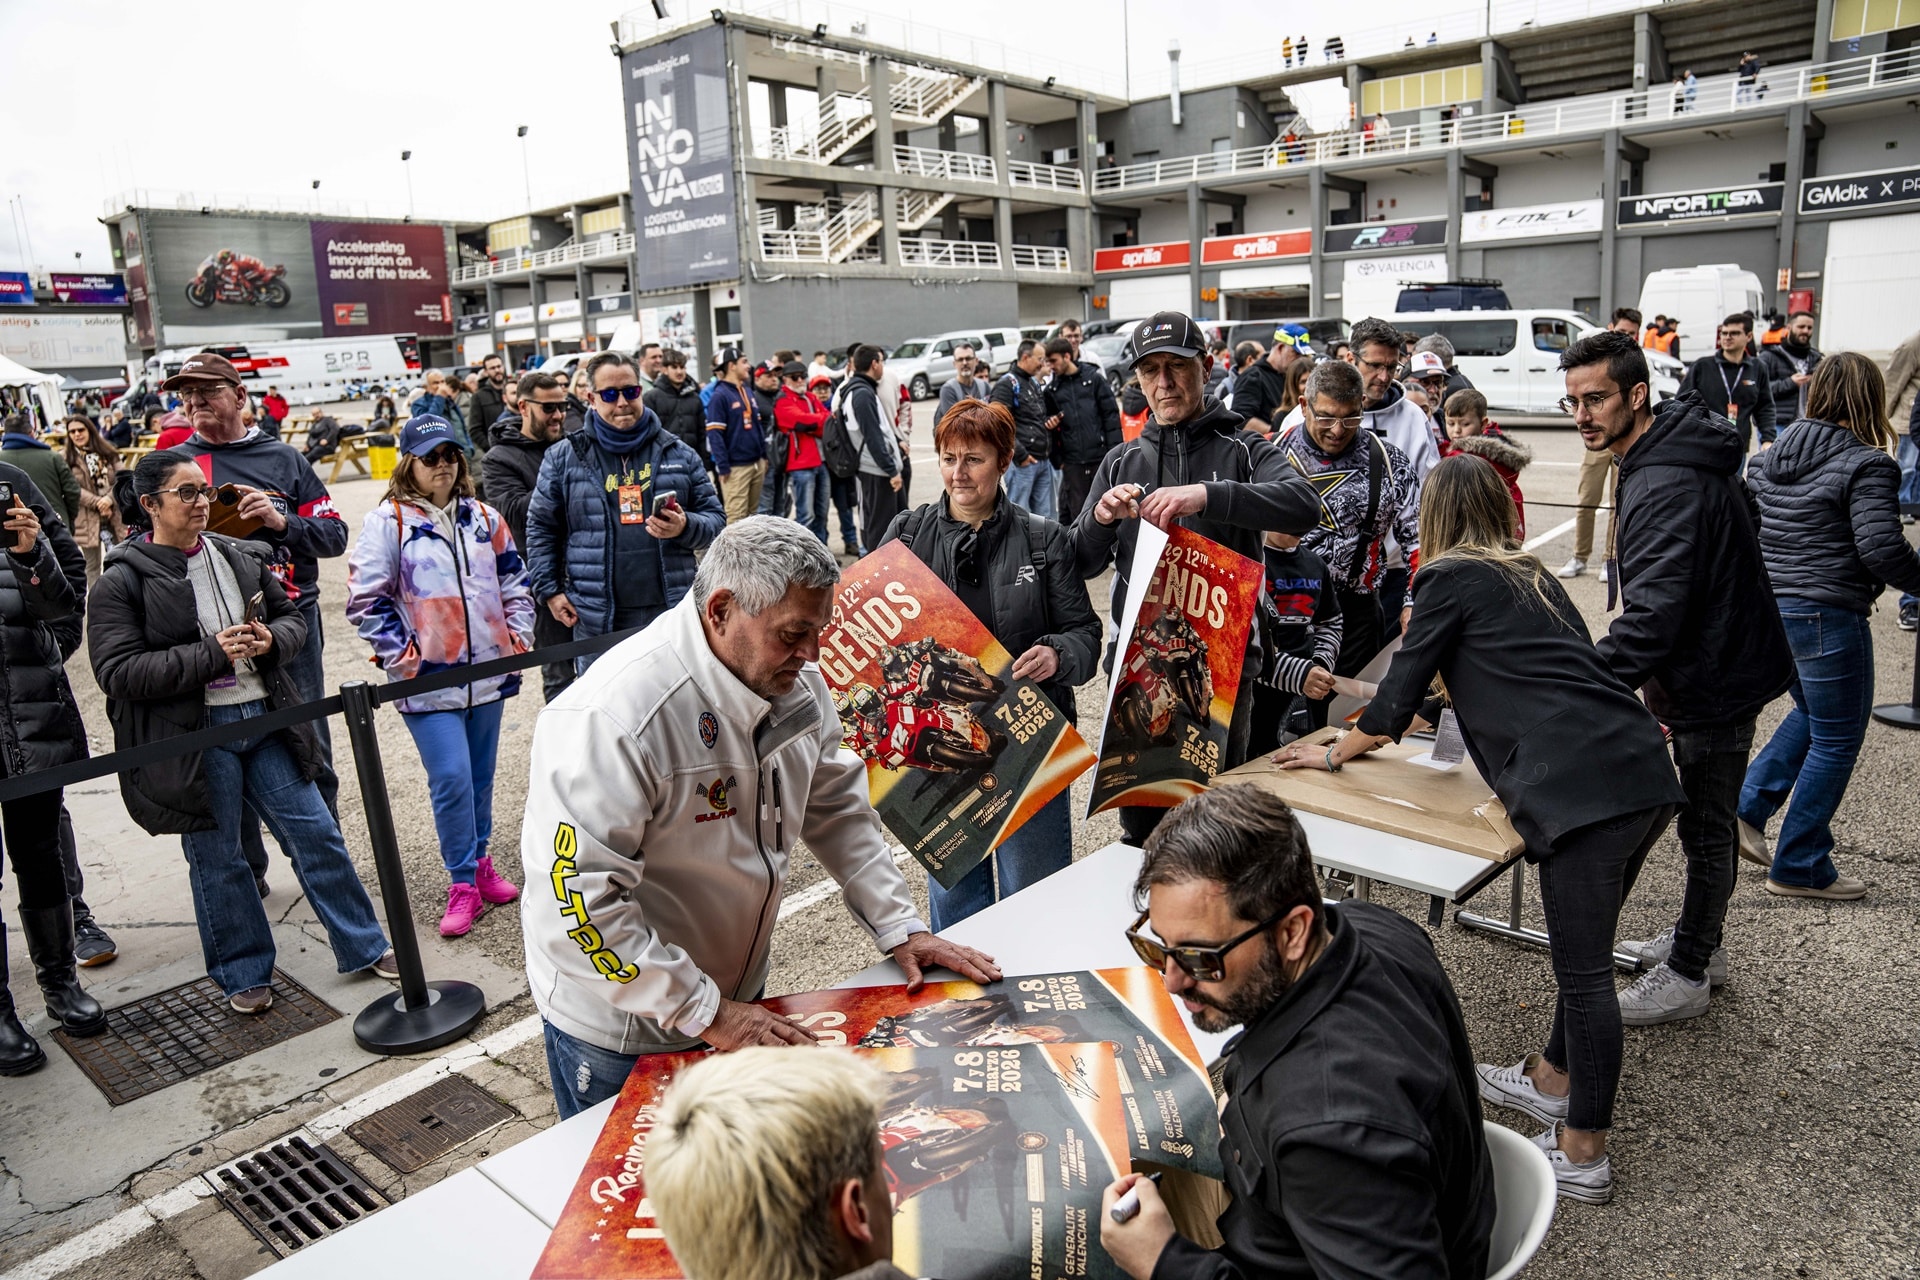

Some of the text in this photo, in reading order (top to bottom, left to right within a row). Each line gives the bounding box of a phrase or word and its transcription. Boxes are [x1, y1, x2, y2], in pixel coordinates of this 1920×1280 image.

[635, 95, 672, 137] IN
[638, 128, 694, 173] NO
[641, 166, 692, 207] VA
[1807, 183, 1869, 205] GMdix
[1879, 180, 1894, 197] X
[1635, 190, 1764, 216] INFORTISA
[327, 239, 405, 255] Accelerating
[644, 225, 666, 239] PARA
[1233, 238, 1275, 258] aprilia
[328, 253, 412, 266] innovation on
[330, 267, 432, 280] and off the track.
[1122, 248, 1162, 268] aprilia
[1378, 260, 1435, 273] VALENCIA
[324, 351, 369, 366] SPR
[994, 686, 1037, 724] 7 y 8
[1008, 701, 1045, 734] marzo
[1015, 707, 1055, 745] 2026
[1186, 724, 1219, 760] 7 y 8
[1180, 748, 1217, 778] 2026
[1183, 740, 1218, 768] marzo
[914, 819, 949, 851] LAS PROVINCIAS
[934, 828, 965, 857] GENERALITAT
[939, 834, 968, 861] VALENCIANA
[1018, 979, 1046, 992] 8
[1047, 978, 1067, 1011] marzo
[1060, 975, 1087, 1010] 2026
[1023, 1000, 1051, 1013] 7
[953, 1051, 985, 1092] 7 y 8
[986, 1050, 999, 1092] marzo
[1000, 1049, 1021, 1092] 2026
[1125, 1096, 1150, 1150] LAS PROVINCIAS
[1153, 1090, 1175, 1138] GENERALITAT
[1164, 1089, 1184, 1139] VALENCIANA
[1031, 1207, 1043, 1264] PROVINCIAS
[1065, 1204, 1076, 1275] GENERALITAT
[1076, 1208, 1087, 1276] VALENCIANA
[1031, 1264, 1042, 1280] AS
